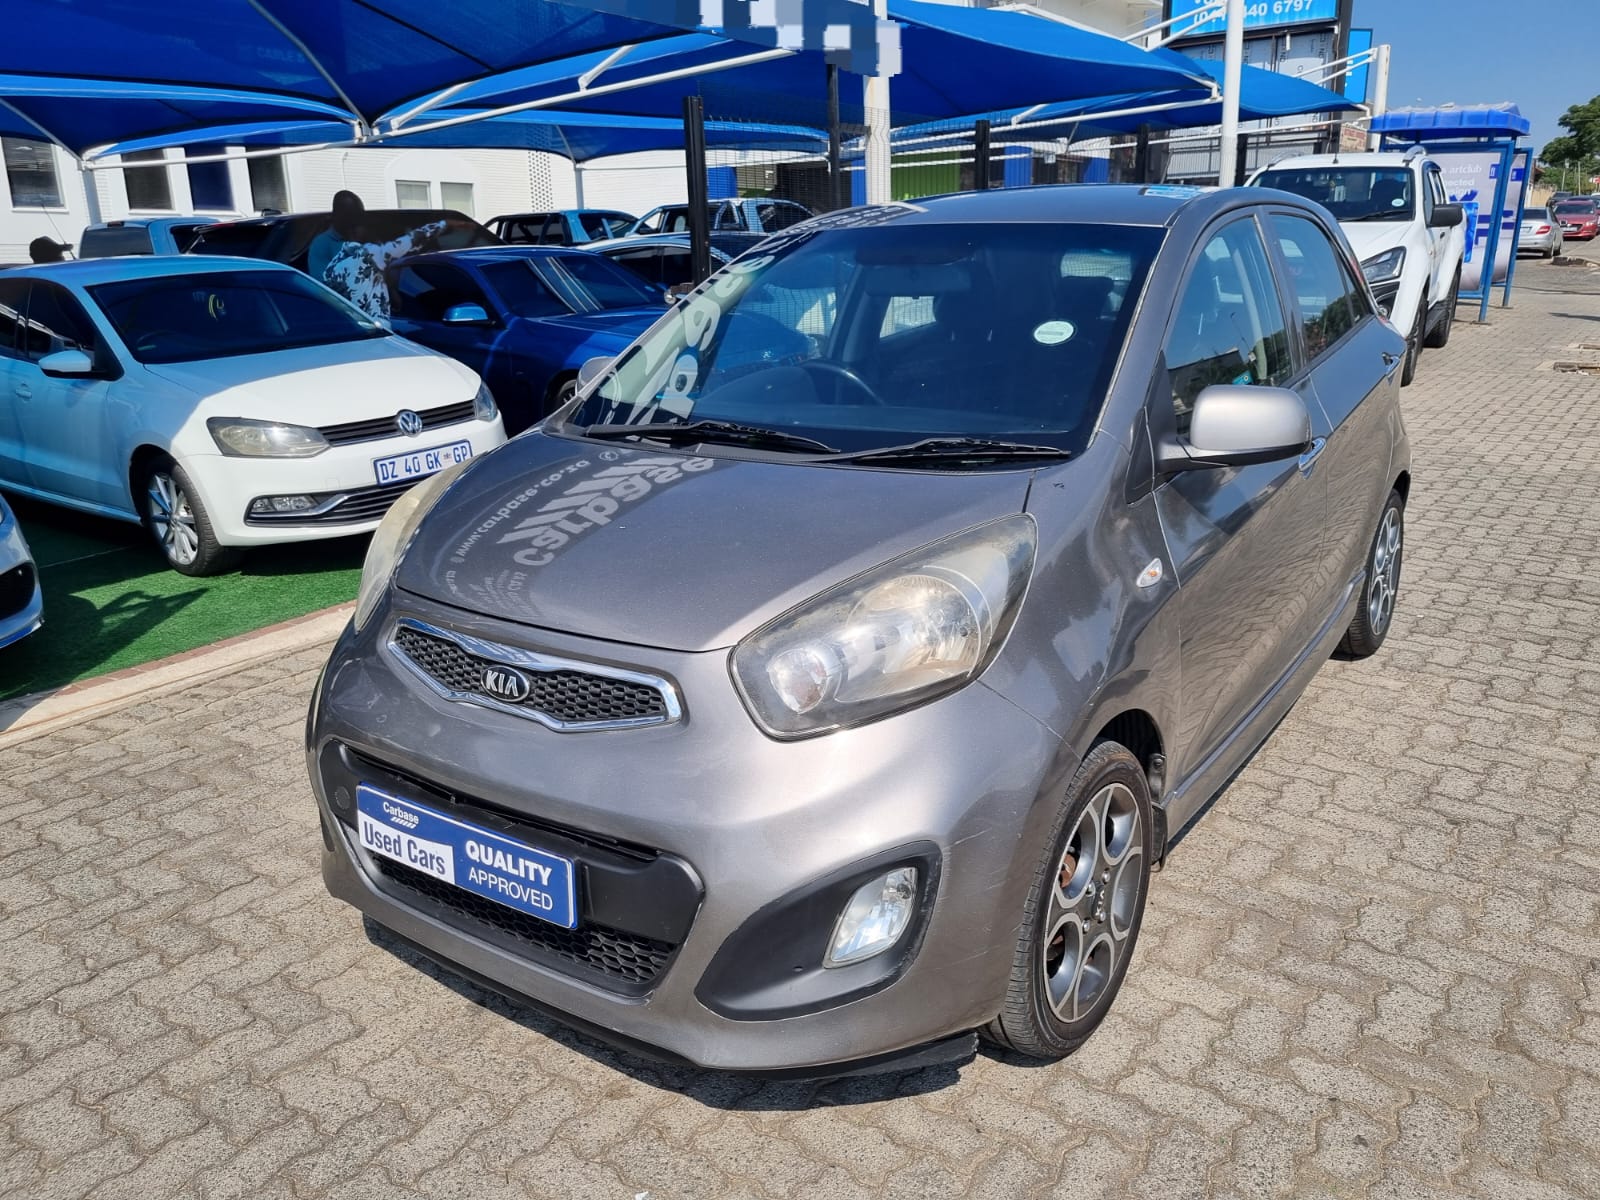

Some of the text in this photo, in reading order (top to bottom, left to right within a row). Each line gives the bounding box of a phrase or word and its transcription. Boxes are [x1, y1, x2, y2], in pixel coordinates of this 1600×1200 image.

[1272, 0, 1313, 14] 6797
[380, 445, 468, 481] DZ 40 GK GP
[484, 670, 519, 697] KIA
[383, 801, 420, 825] Carbase
[363, 820, 446, 877] Used Cars
[465, 840, 552, 886] QUALITY
[468, 868, 554, 912] APPROVED
